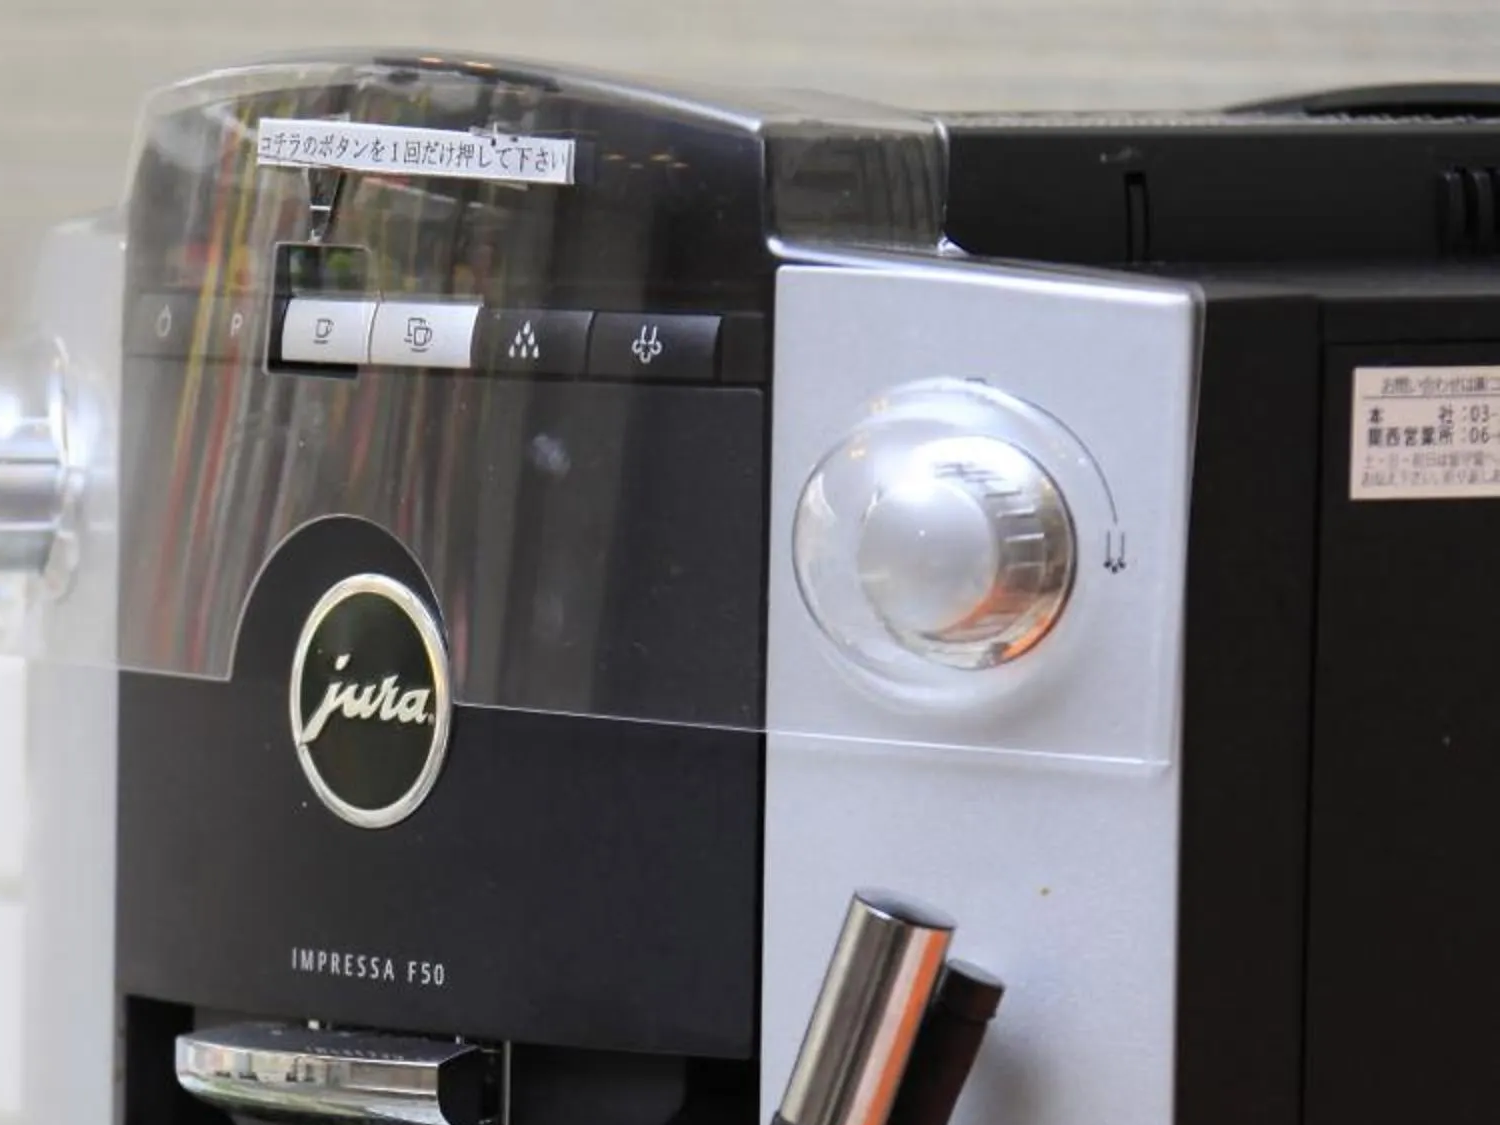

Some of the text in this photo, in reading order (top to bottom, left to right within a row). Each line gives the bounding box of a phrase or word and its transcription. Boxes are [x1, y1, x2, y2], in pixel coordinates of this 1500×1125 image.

[301, 654, 431, 743] jura
[291, 947, 446, 986] IMPRESSA F50
